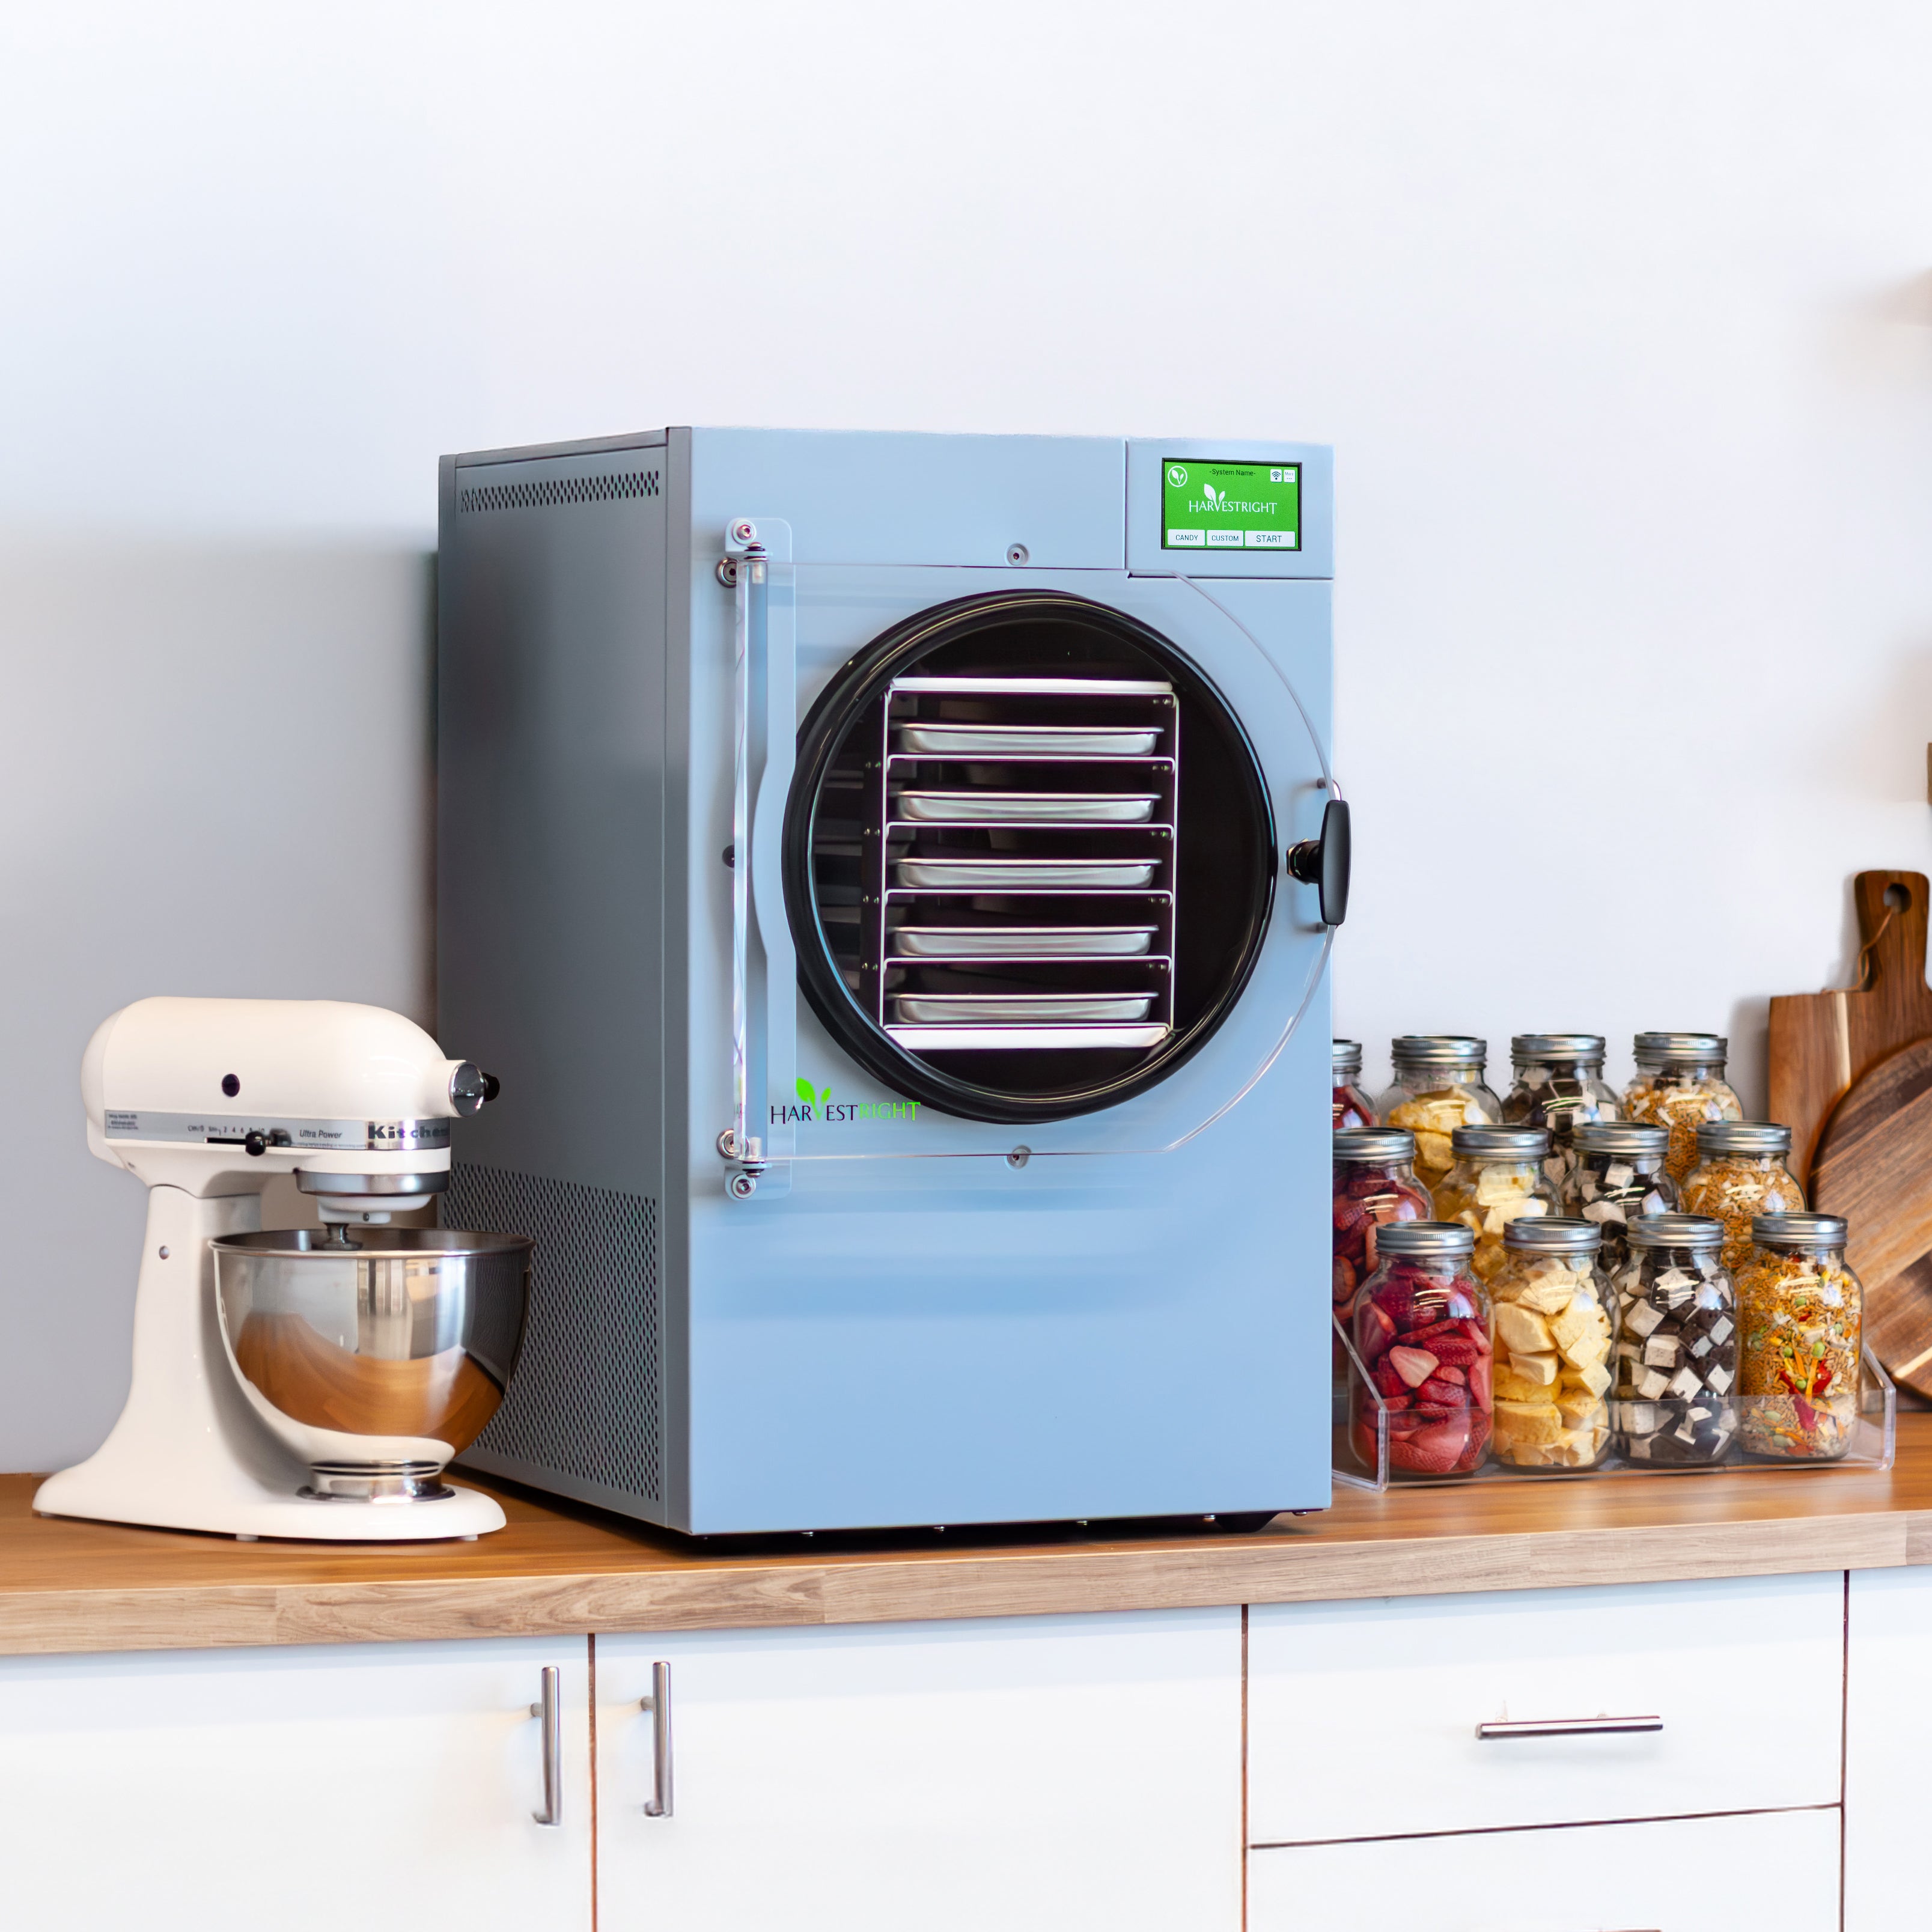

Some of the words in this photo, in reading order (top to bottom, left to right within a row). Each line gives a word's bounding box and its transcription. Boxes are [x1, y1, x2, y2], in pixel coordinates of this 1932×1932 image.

[1189, 495, 1278, 514] HARVESTRIGHT
[770, 1097, 921, 1124] HARVESTRIGHT
[299, 1130, 316, 1138] Ultra
[318, 1130, 343, 1139] Power
